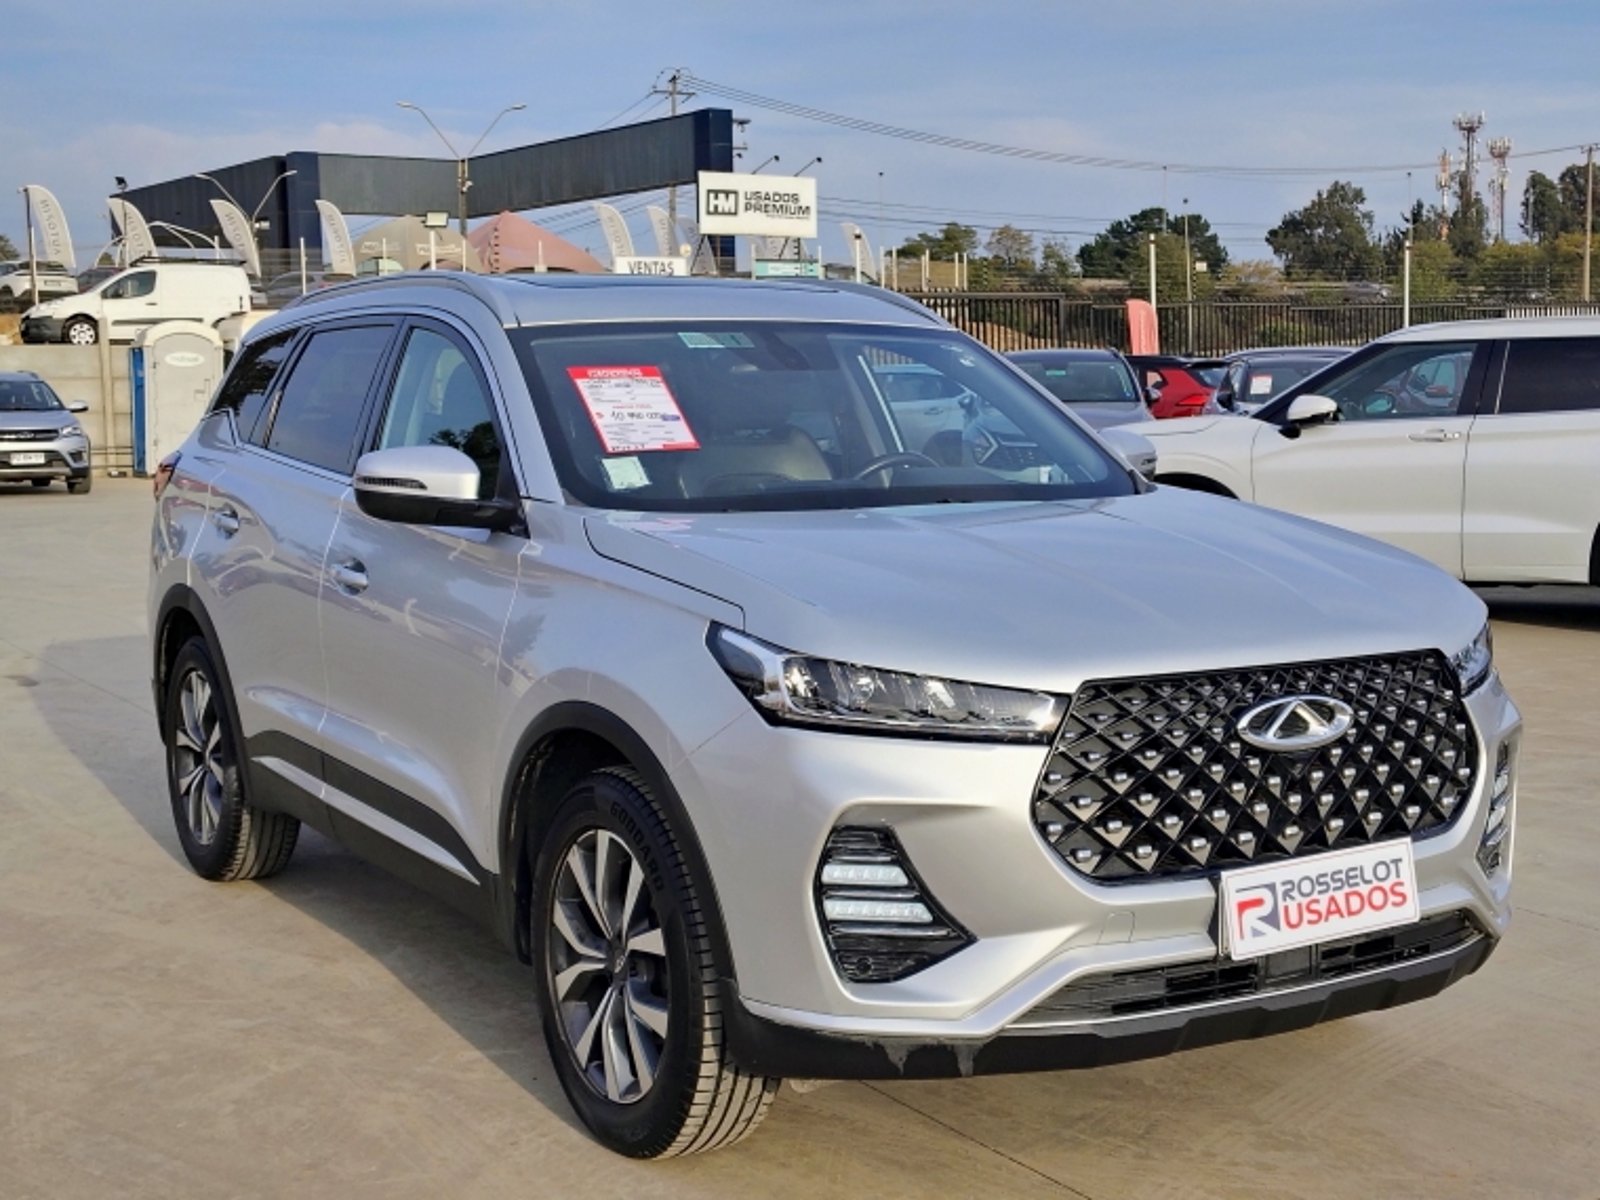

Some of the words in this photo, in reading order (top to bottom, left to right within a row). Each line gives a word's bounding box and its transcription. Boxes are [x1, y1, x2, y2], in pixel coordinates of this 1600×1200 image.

[707, 190, 738, 215] HM
[744, 191, 800, 204] USADOS
[744, 202, 811, 216] PREMIUM
[627, 260, 674, 276] VENTAS
[1281, 858, 1403, 902] ROSSELOT
[1283, 881, 1408, 930] USADOS
